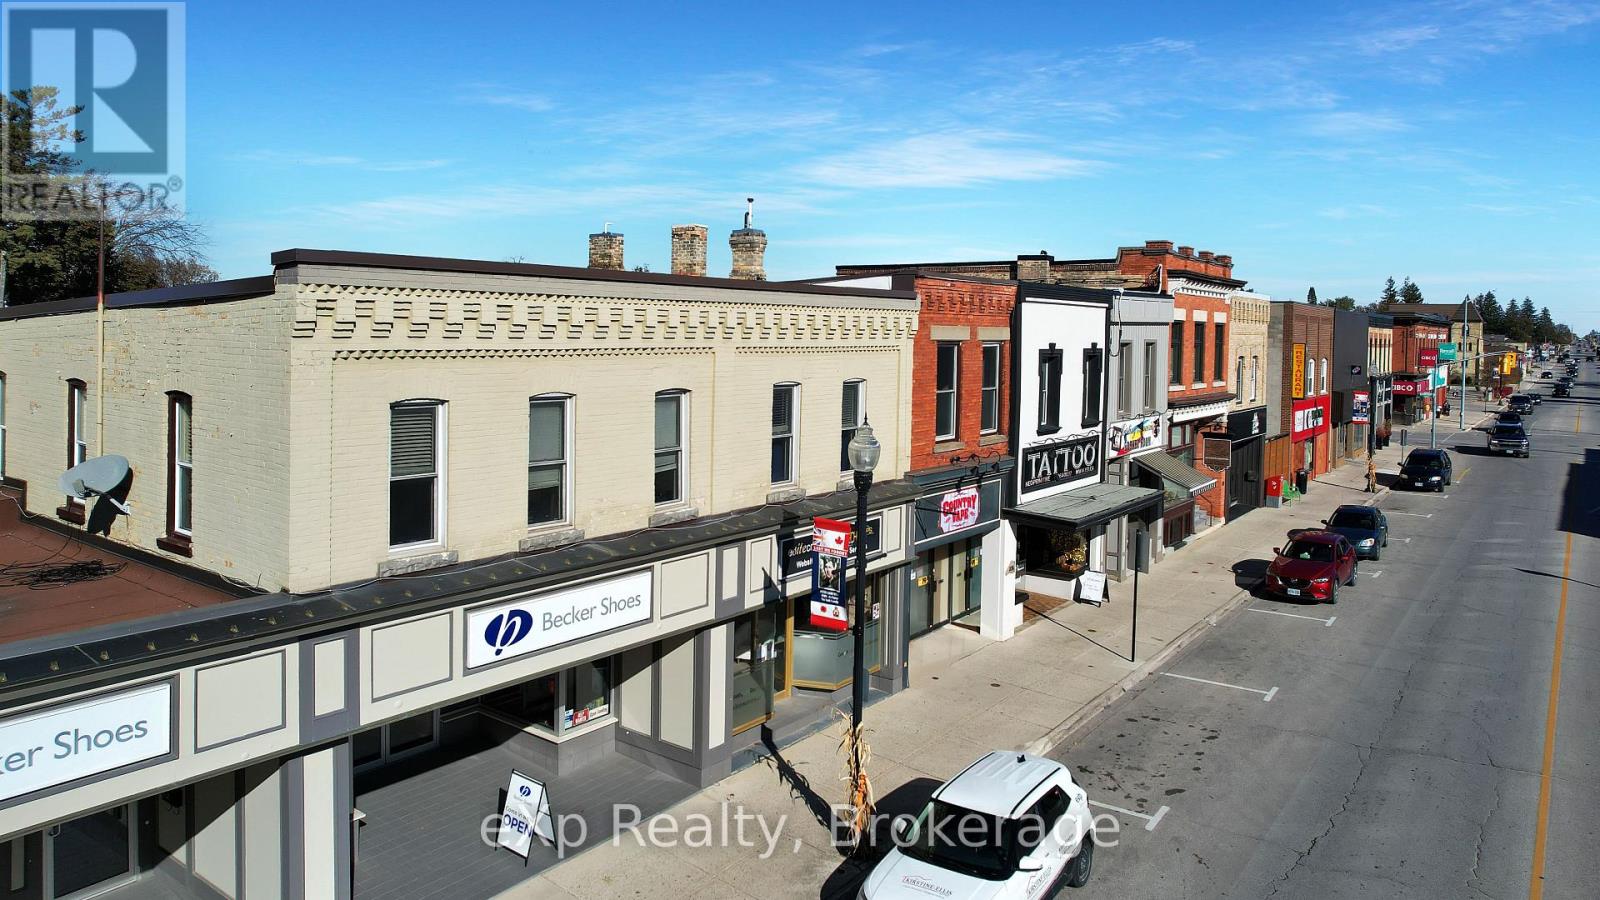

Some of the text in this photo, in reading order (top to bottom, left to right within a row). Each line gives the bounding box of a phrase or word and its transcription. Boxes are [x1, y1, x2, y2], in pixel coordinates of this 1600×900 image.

[1295, 350, 1303, 396] RESTAURANT
[1028, 441, 1097, 479] TATTOO
[943, 494, 977, 516] COUNTRY
[542, 594, 641, 632] Becker Shoes
[54, 720, 148, 759] Shoes
[503, 814, 533, 838] OPEN
